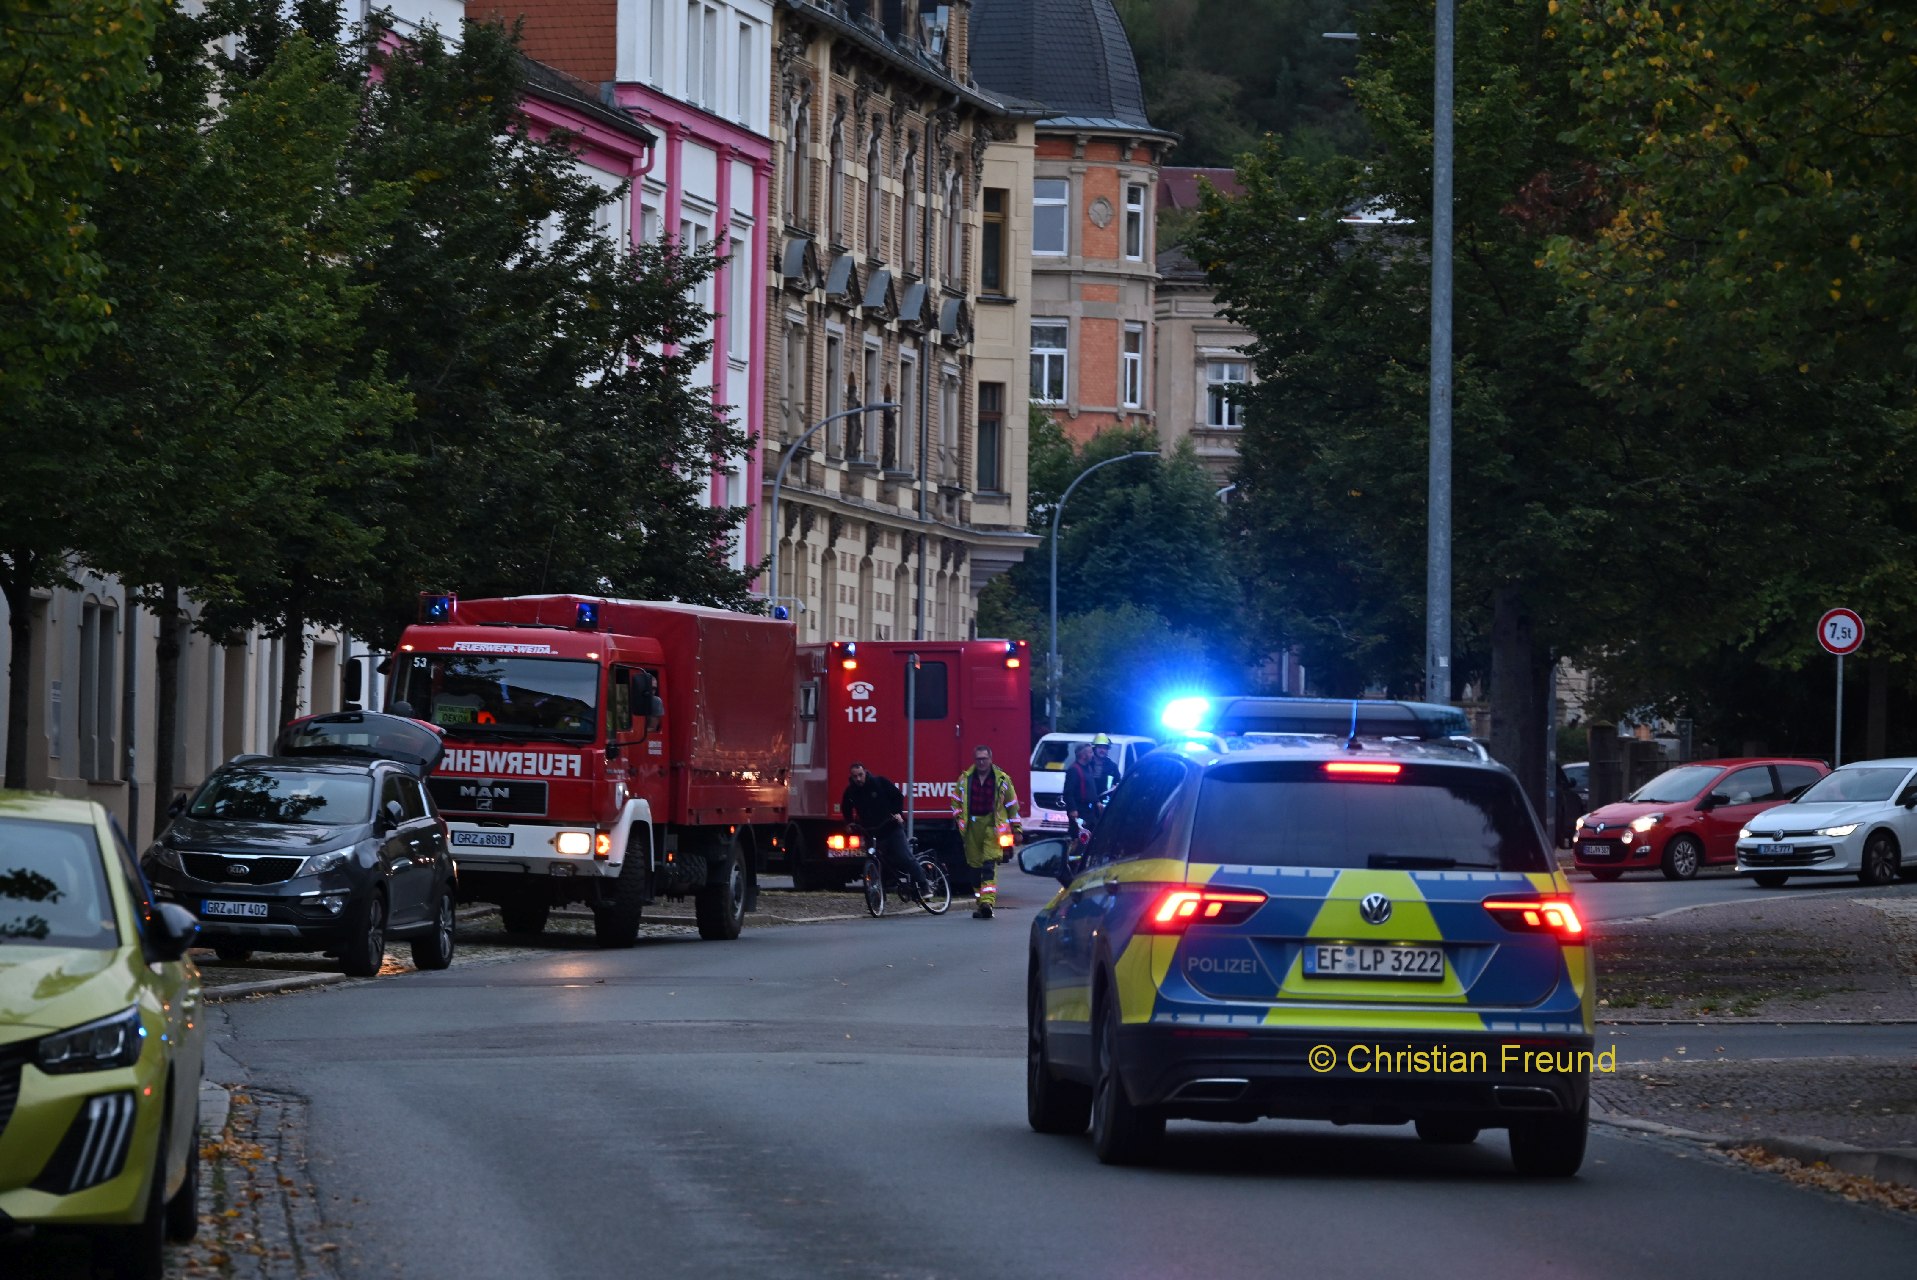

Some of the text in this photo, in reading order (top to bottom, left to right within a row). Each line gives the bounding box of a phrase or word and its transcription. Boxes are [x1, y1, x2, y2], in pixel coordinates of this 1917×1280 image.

[413, 656, 427, 668] 53
[845, 705, 877, 723] 112
[459, 785, 510, 798] MAN
[457, 833, 507, 845] GRZ 8018
[207, 902, 267, 916] GRZ UT 402
[1187, 957, 1257, 974] POLIZEI
[1317, 945, 1442, 973] EF LP 3222
